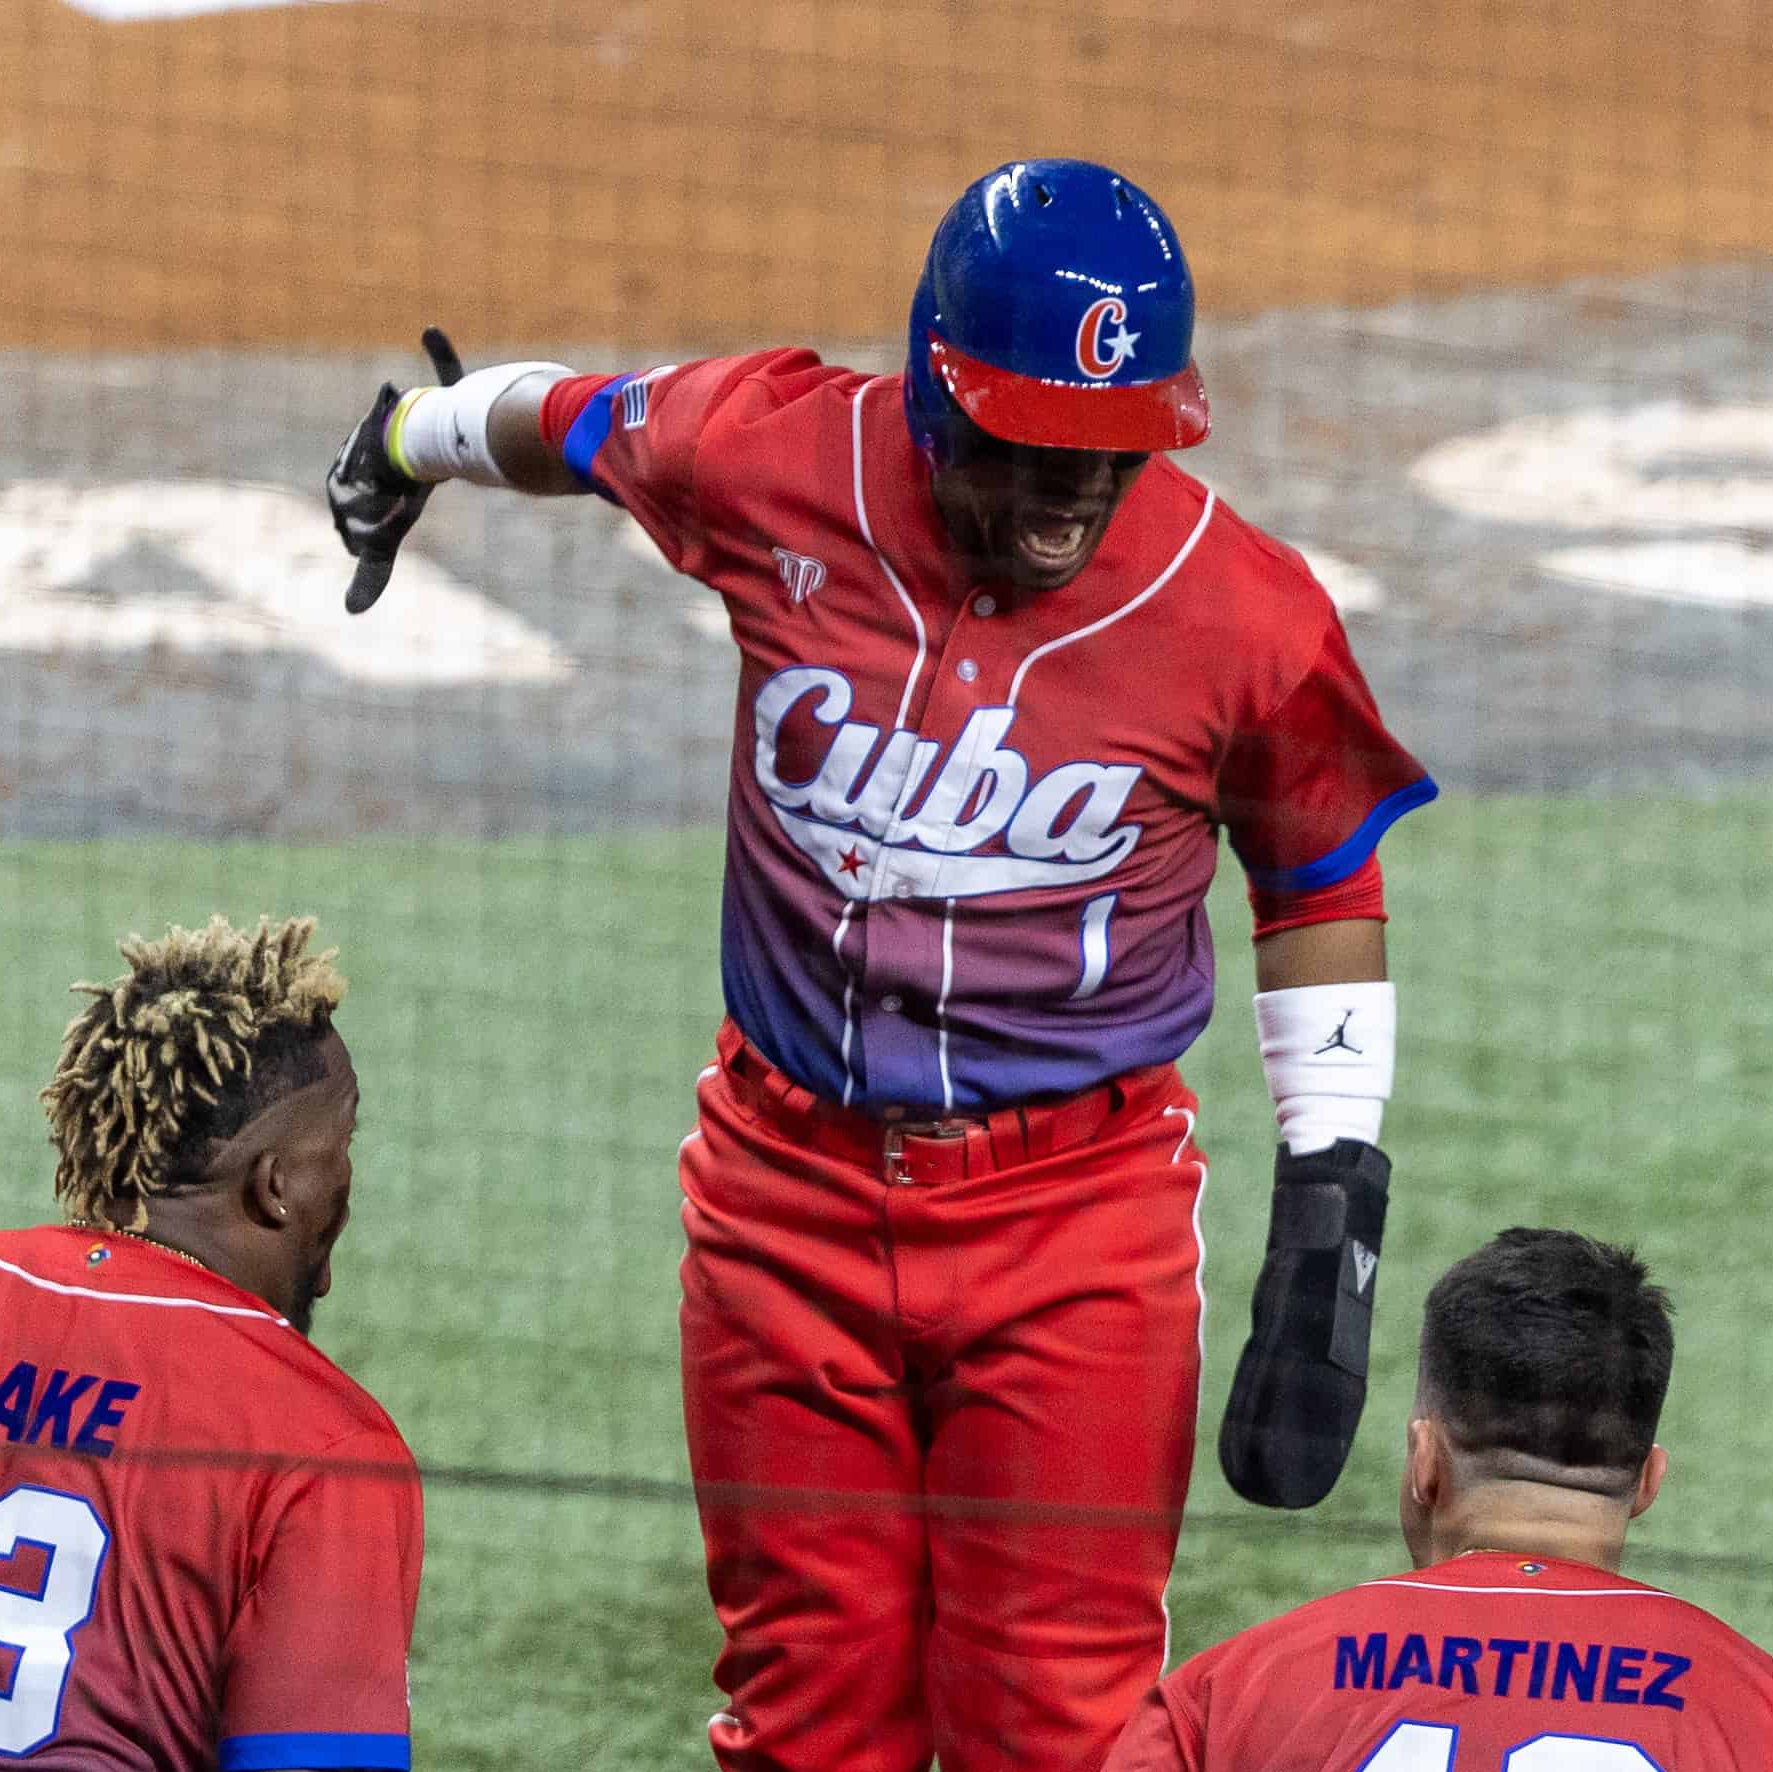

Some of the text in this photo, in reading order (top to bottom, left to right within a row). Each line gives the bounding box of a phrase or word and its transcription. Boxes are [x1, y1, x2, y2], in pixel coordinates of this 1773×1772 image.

[1075, 297, 1128, 380] C
[754, 664, 1146, 866] Cuba
[1069, 890, 1119, 1001] 1
[1333, 1631, 1692, 1711] MARTINEZ
